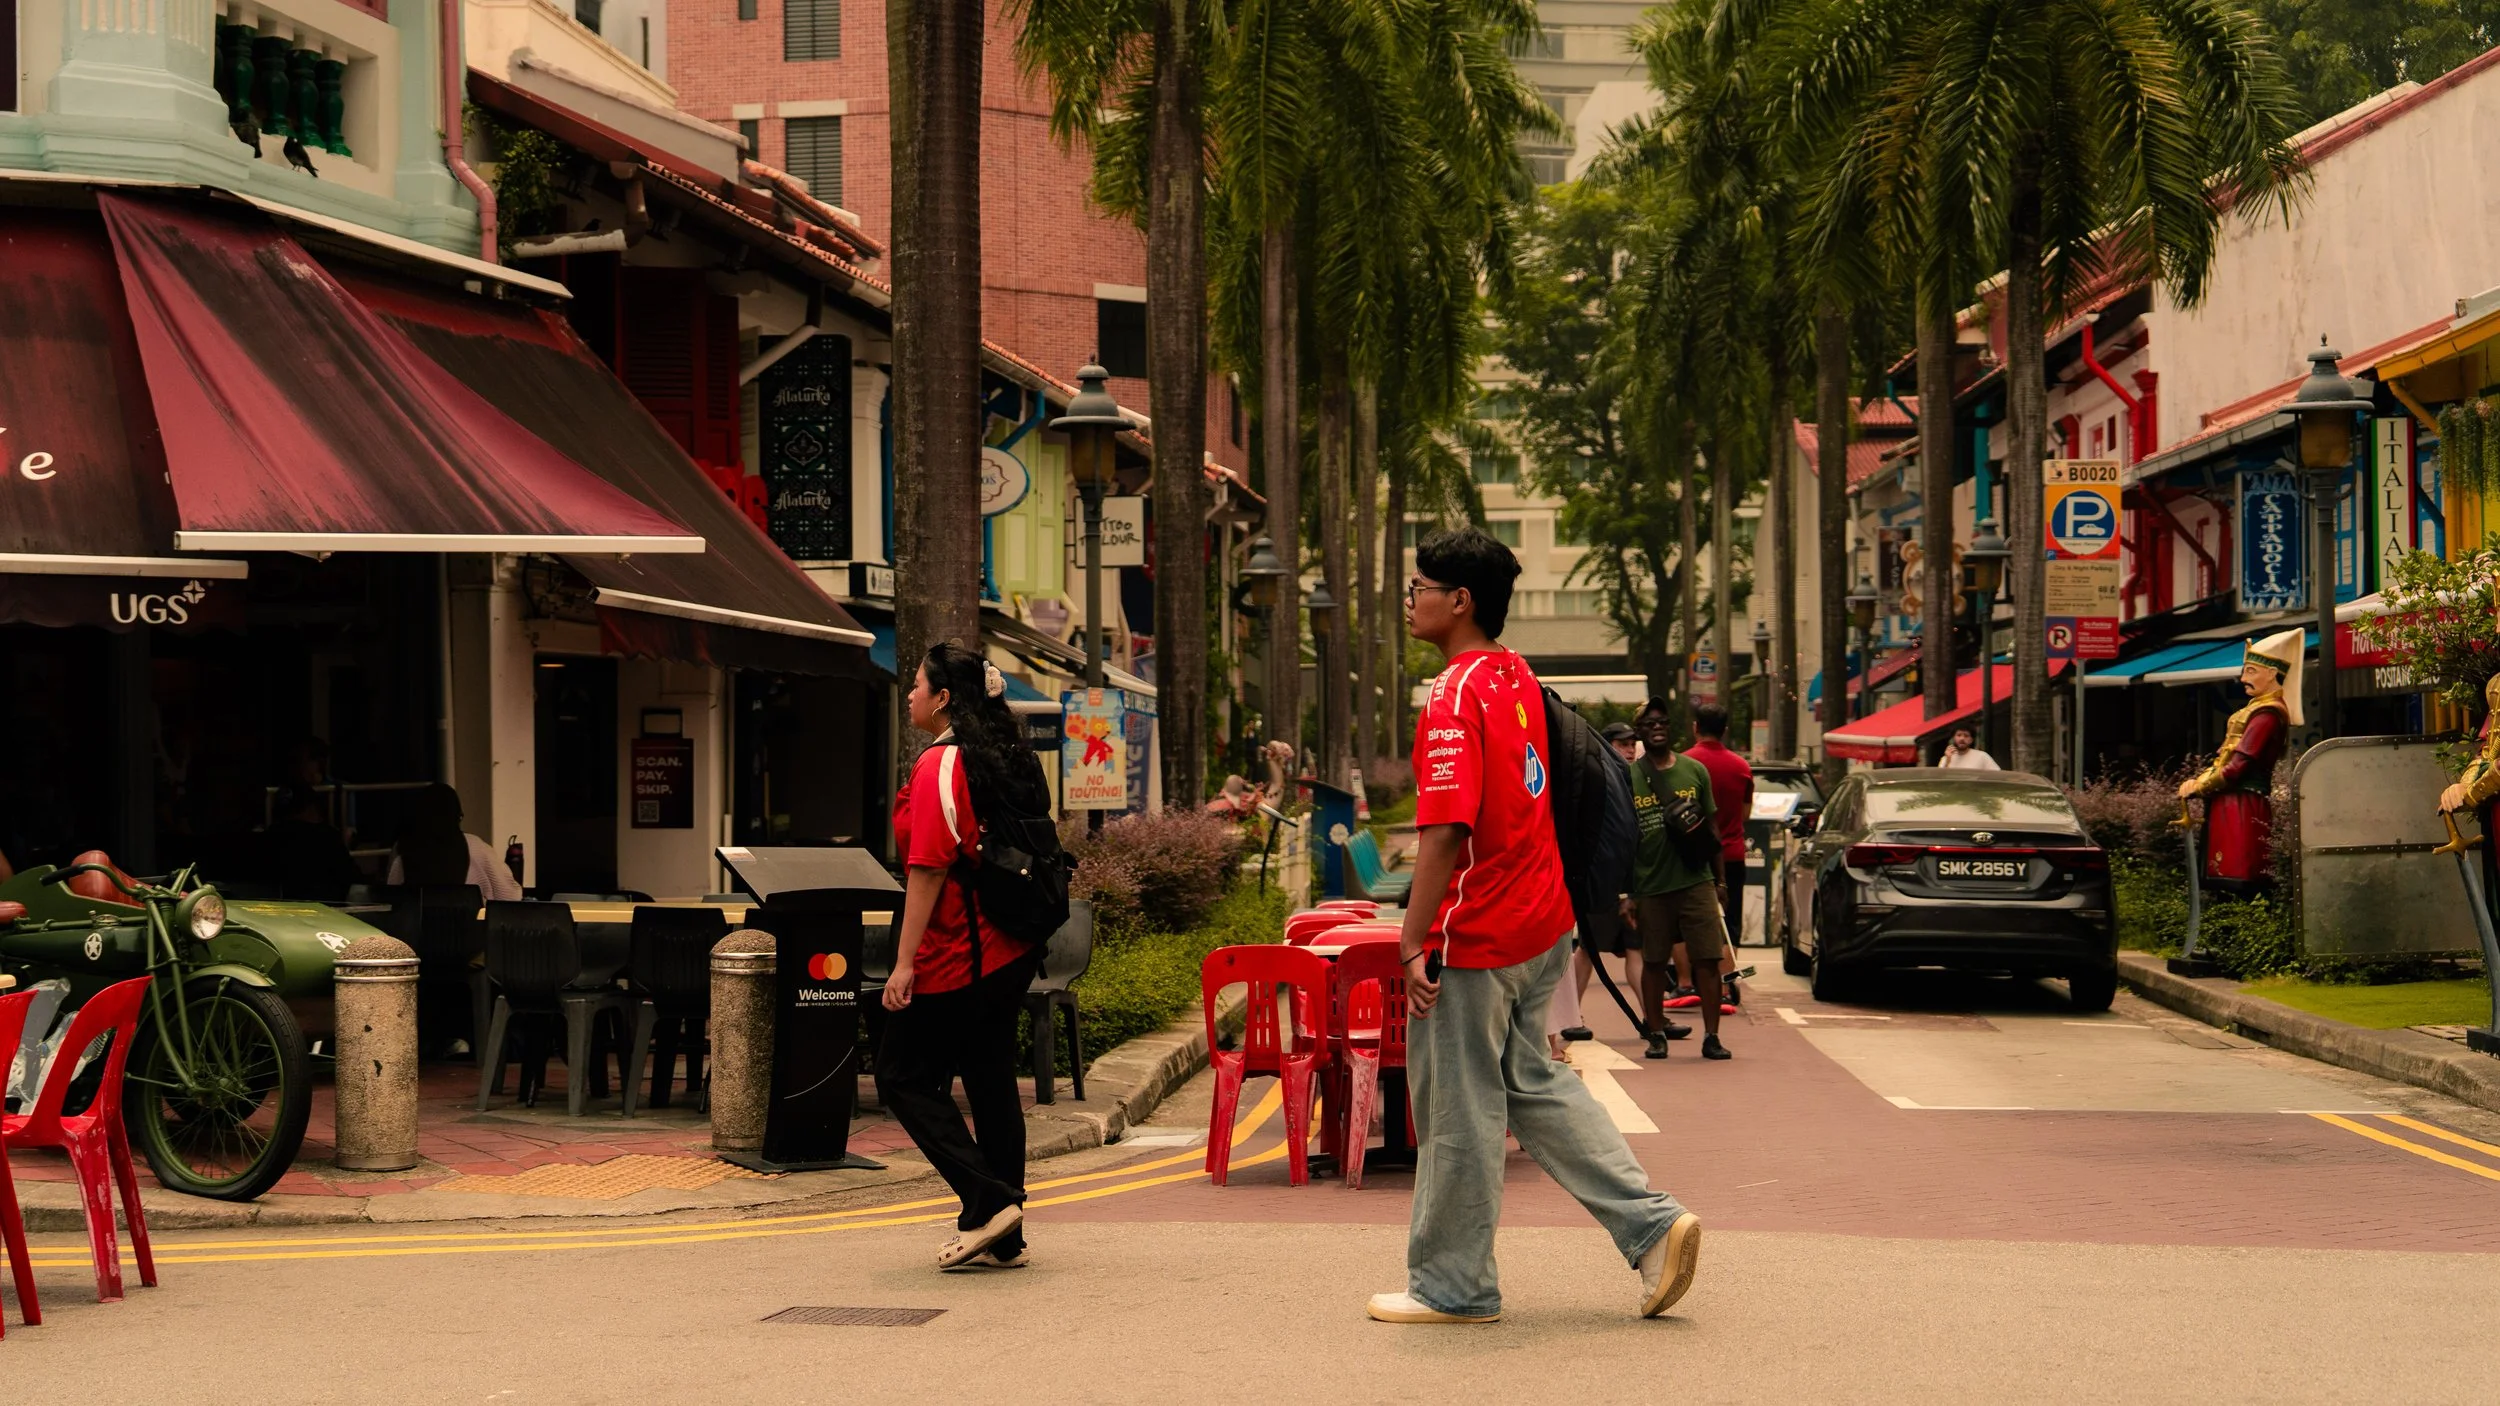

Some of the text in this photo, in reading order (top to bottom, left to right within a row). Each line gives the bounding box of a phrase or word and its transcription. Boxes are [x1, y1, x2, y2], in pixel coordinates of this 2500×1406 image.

[773, 385, 831, 407] Alaturka
[2069, 467, 2117, 481] B0020
[774, 489, 832, 511] Alaturka
[2065, 496, 2108, 537] P
[2259, 493, 2283, 593] CAPPADOCIA
[110, 593, 188, 625] UGS
[1427, 746, 1458, 758] ambipar
[636, 757, 682, 767] SCAN.
[636, 770, 667, 780] PAY.
[1086, 775, 1104, 786] NO
[636, 784, 673, 795] SKIP.
[1069, 786, 1123, 799] TOUTING!
[1634, 787, 1697, 809] Reted
[1939, 861, 2026, 877] SMK 2856 Y
[798, 989, 855, 1001] Welcome
